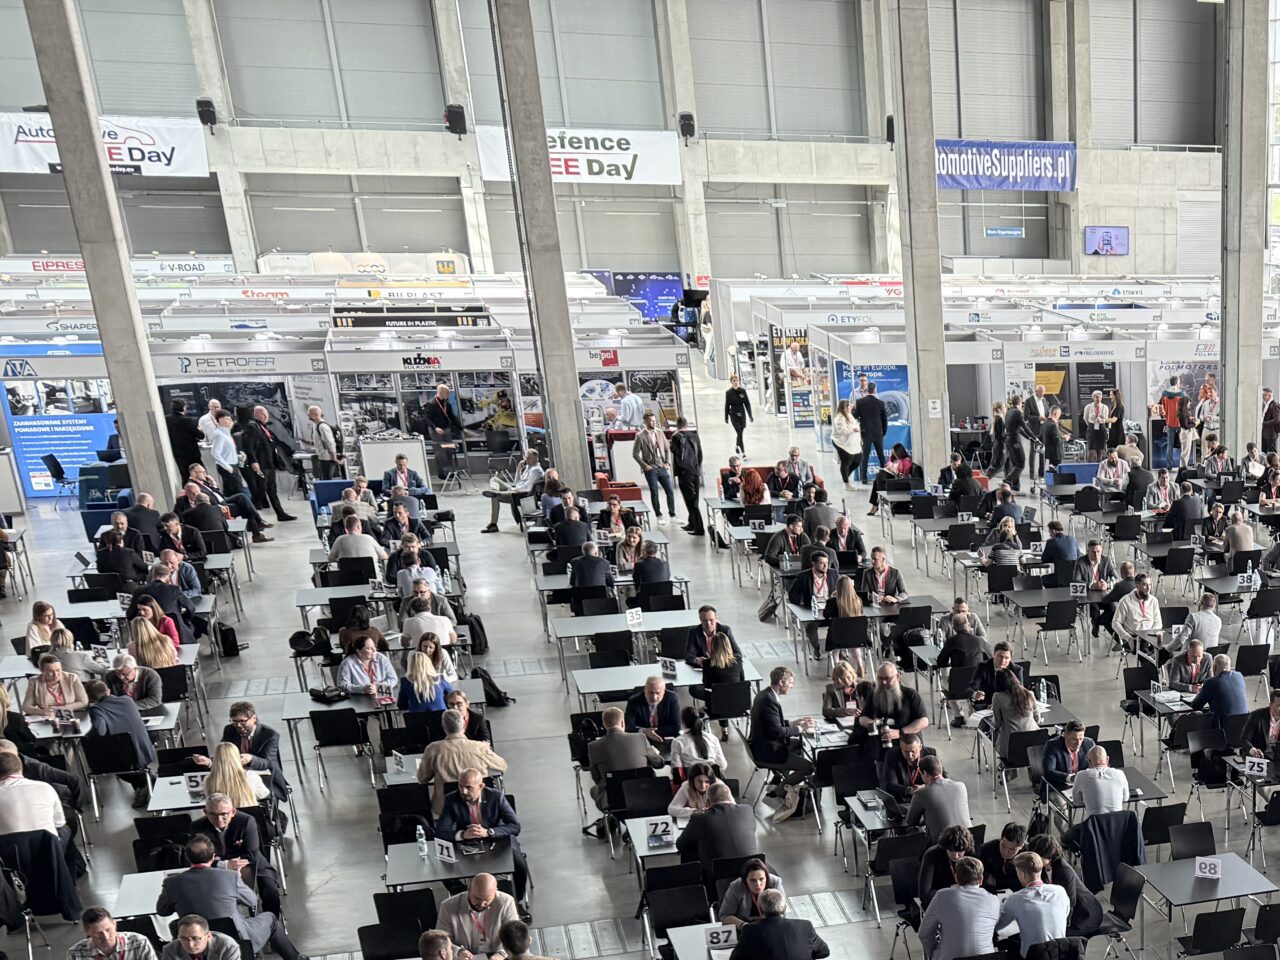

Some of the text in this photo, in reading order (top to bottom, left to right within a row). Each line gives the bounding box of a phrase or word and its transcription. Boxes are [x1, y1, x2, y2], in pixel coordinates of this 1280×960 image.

[547, 131, 631, 150] efence
[128, 146, 176, 166] Day
[586, 154, 638, 180] Day
[935, 147, 1069, 182] tomotiveSuppliers.pl
[32, 261, 84, 272] ELPRES
[168, 263, 205, 272] V-ROAD
[196, 356, 276, 366] PETROFER
[313, 360, 324, 370] 58
[502, 358, 512, 368] 57
[960, 512, 972, 522] 17
[750, 522, 764, 530] 16
[1238, 574, 1252, 584] 38
[1070, 584, 1086, 594] 37
[628, 610, 642, 622] 35
[662, 658, 676, 672] 45
[376, 684, 391, 698] 44
[1248, 760, 1264, 773] 75
[650, 821, 670, 836] 72
[439, 846, 452, 860] 71
[709, 930, 732, 945] 87
